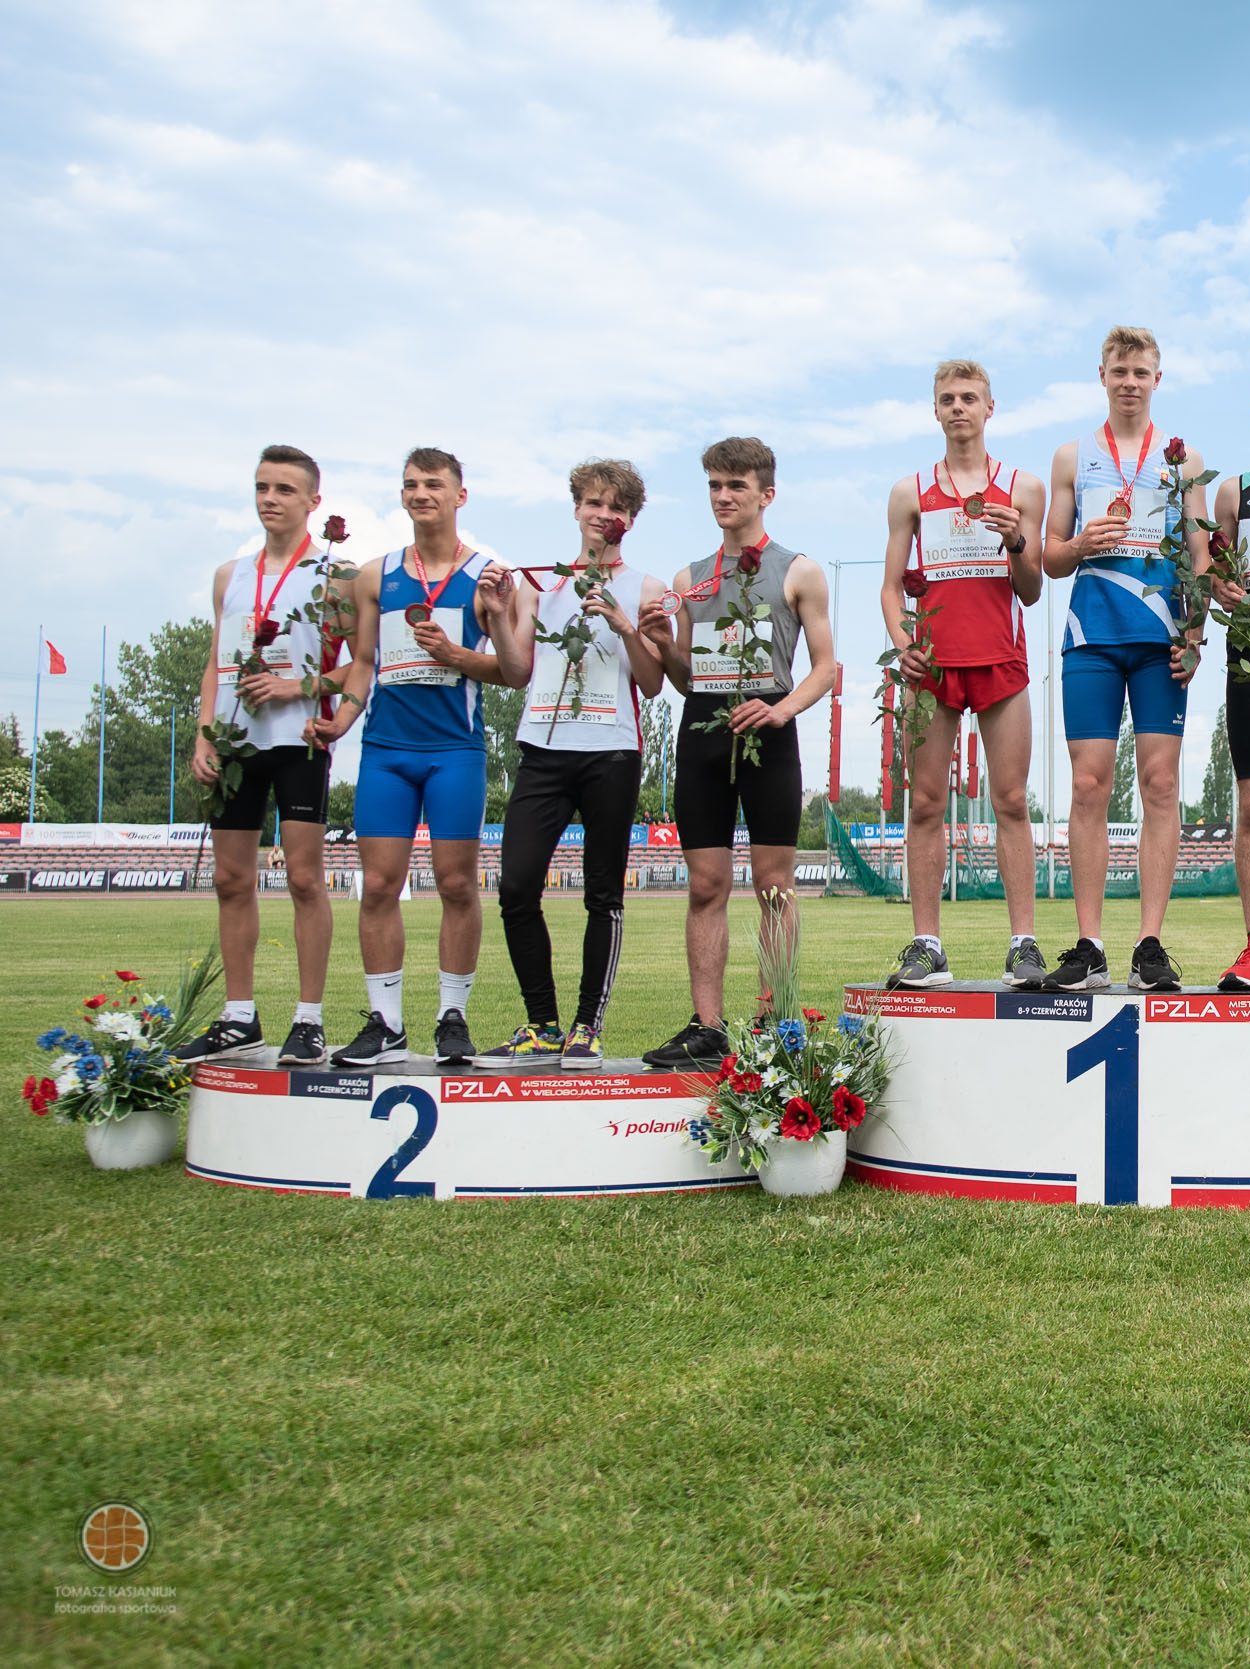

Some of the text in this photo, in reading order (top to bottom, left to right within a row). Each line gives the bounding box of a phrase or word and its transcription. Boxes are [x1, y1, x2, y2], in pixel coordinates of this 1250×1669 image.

[926, 548, 948, 561] 100
[935, 568, 995, 579] KRAKÓW 2019
[694, 660, 717, 673] 100
[741, 680, 761, 689] 2019
[581, 713, 602, 722] 2019
[32, 871, 105, 887] 4MOVE
[112, 871, 184, 887] 4MOVE
[1053, 998, 1087, 1007] KRAKÓW
[913, 1006, 956, 1014] SZTAFETACH
[1018, 1007, 1087, 1017] 8-9 CZERWCA 2019
[1150, 1001, 1220, 1017] PZLA
[338, 1078, 370, 1087] KRAKÓW
[319, 1086, 351, 1095] CZERWCA
[352, 1087, 369, 1095] 2019
[445, 1081, 513, 1097] PZLA
[531, 1089, 605, 1097] WIELOBOJACH
[610, 1086, 671, 1095] SZTAFETACH
[1067, 1004, 1139, 1205] 1
[625, 1118, 689, 1137] polanik
[366, 1085, 439, 1199] 2
